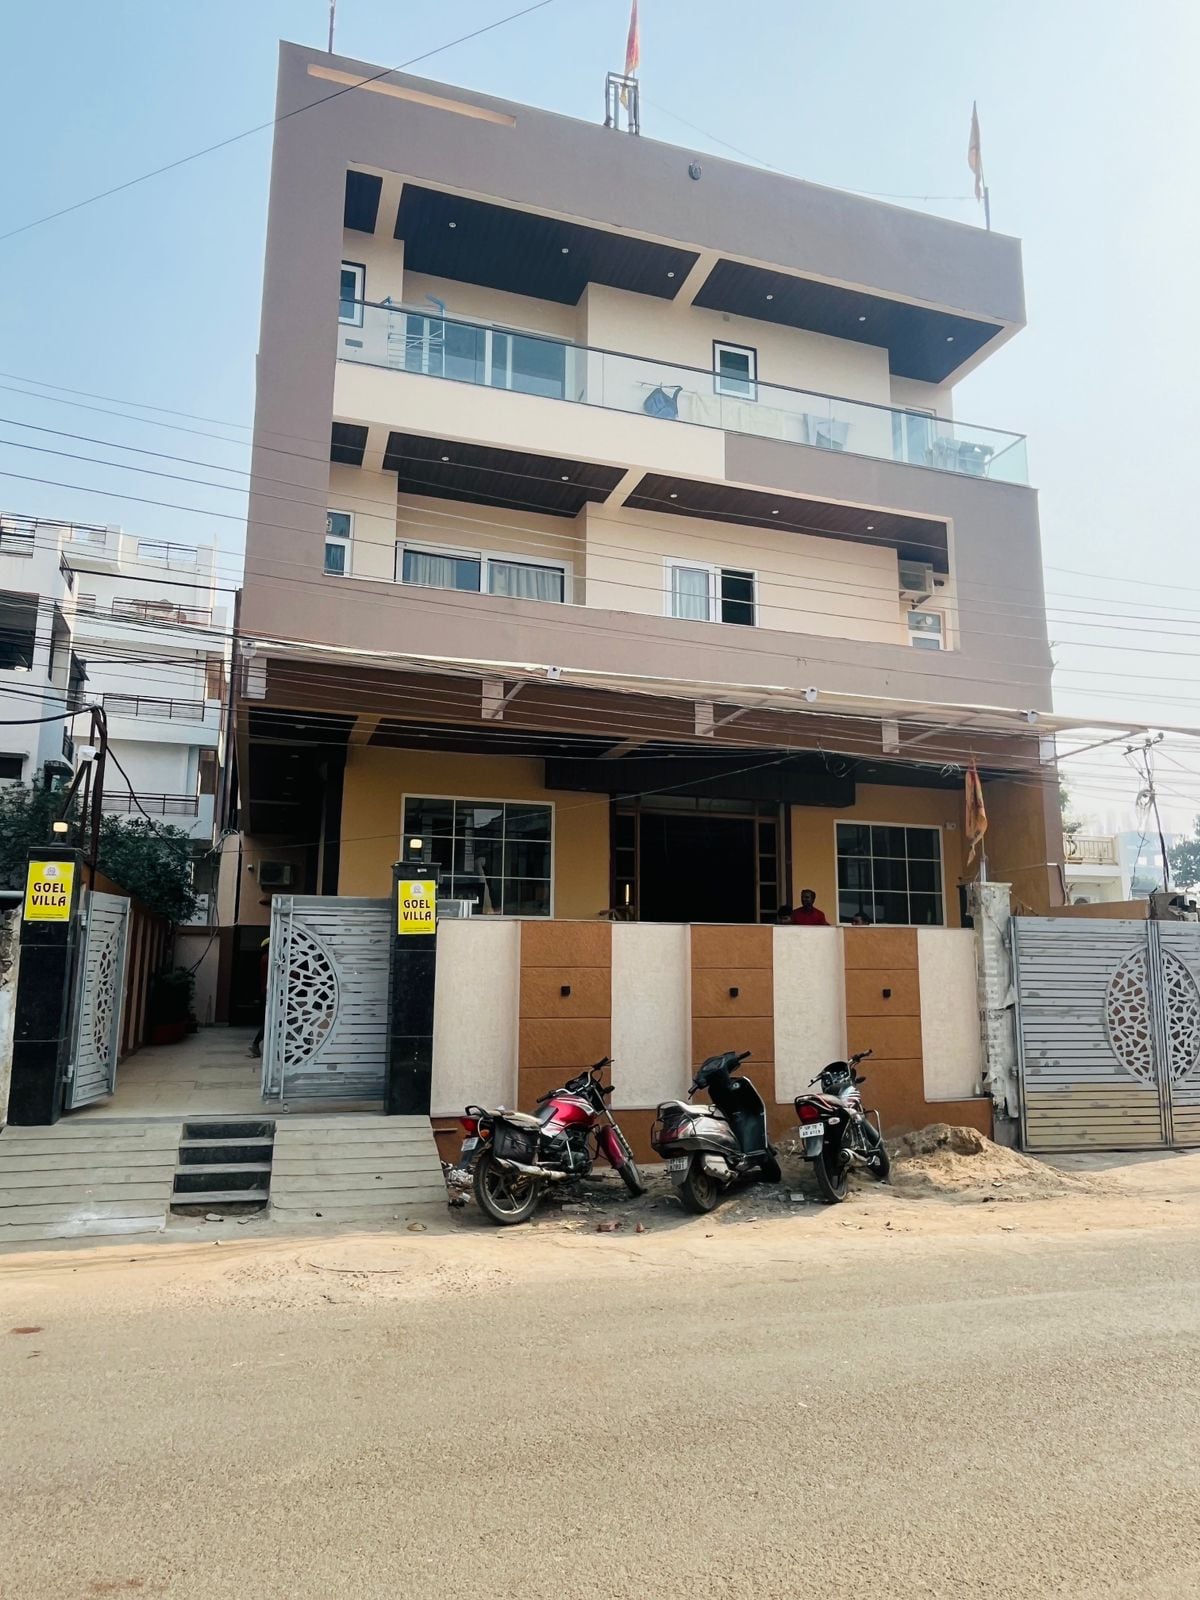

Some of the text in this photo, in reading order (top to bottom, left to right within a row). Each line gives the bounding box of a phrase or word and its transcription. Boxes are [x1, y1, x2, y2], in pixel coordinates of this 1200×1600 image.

[33, 882, 66, 893] GOEL
[31, 895, 67, 907] VILLA
[403, 899, 431, 909] GOEL
[403, 911, 432, 921] VILLA
